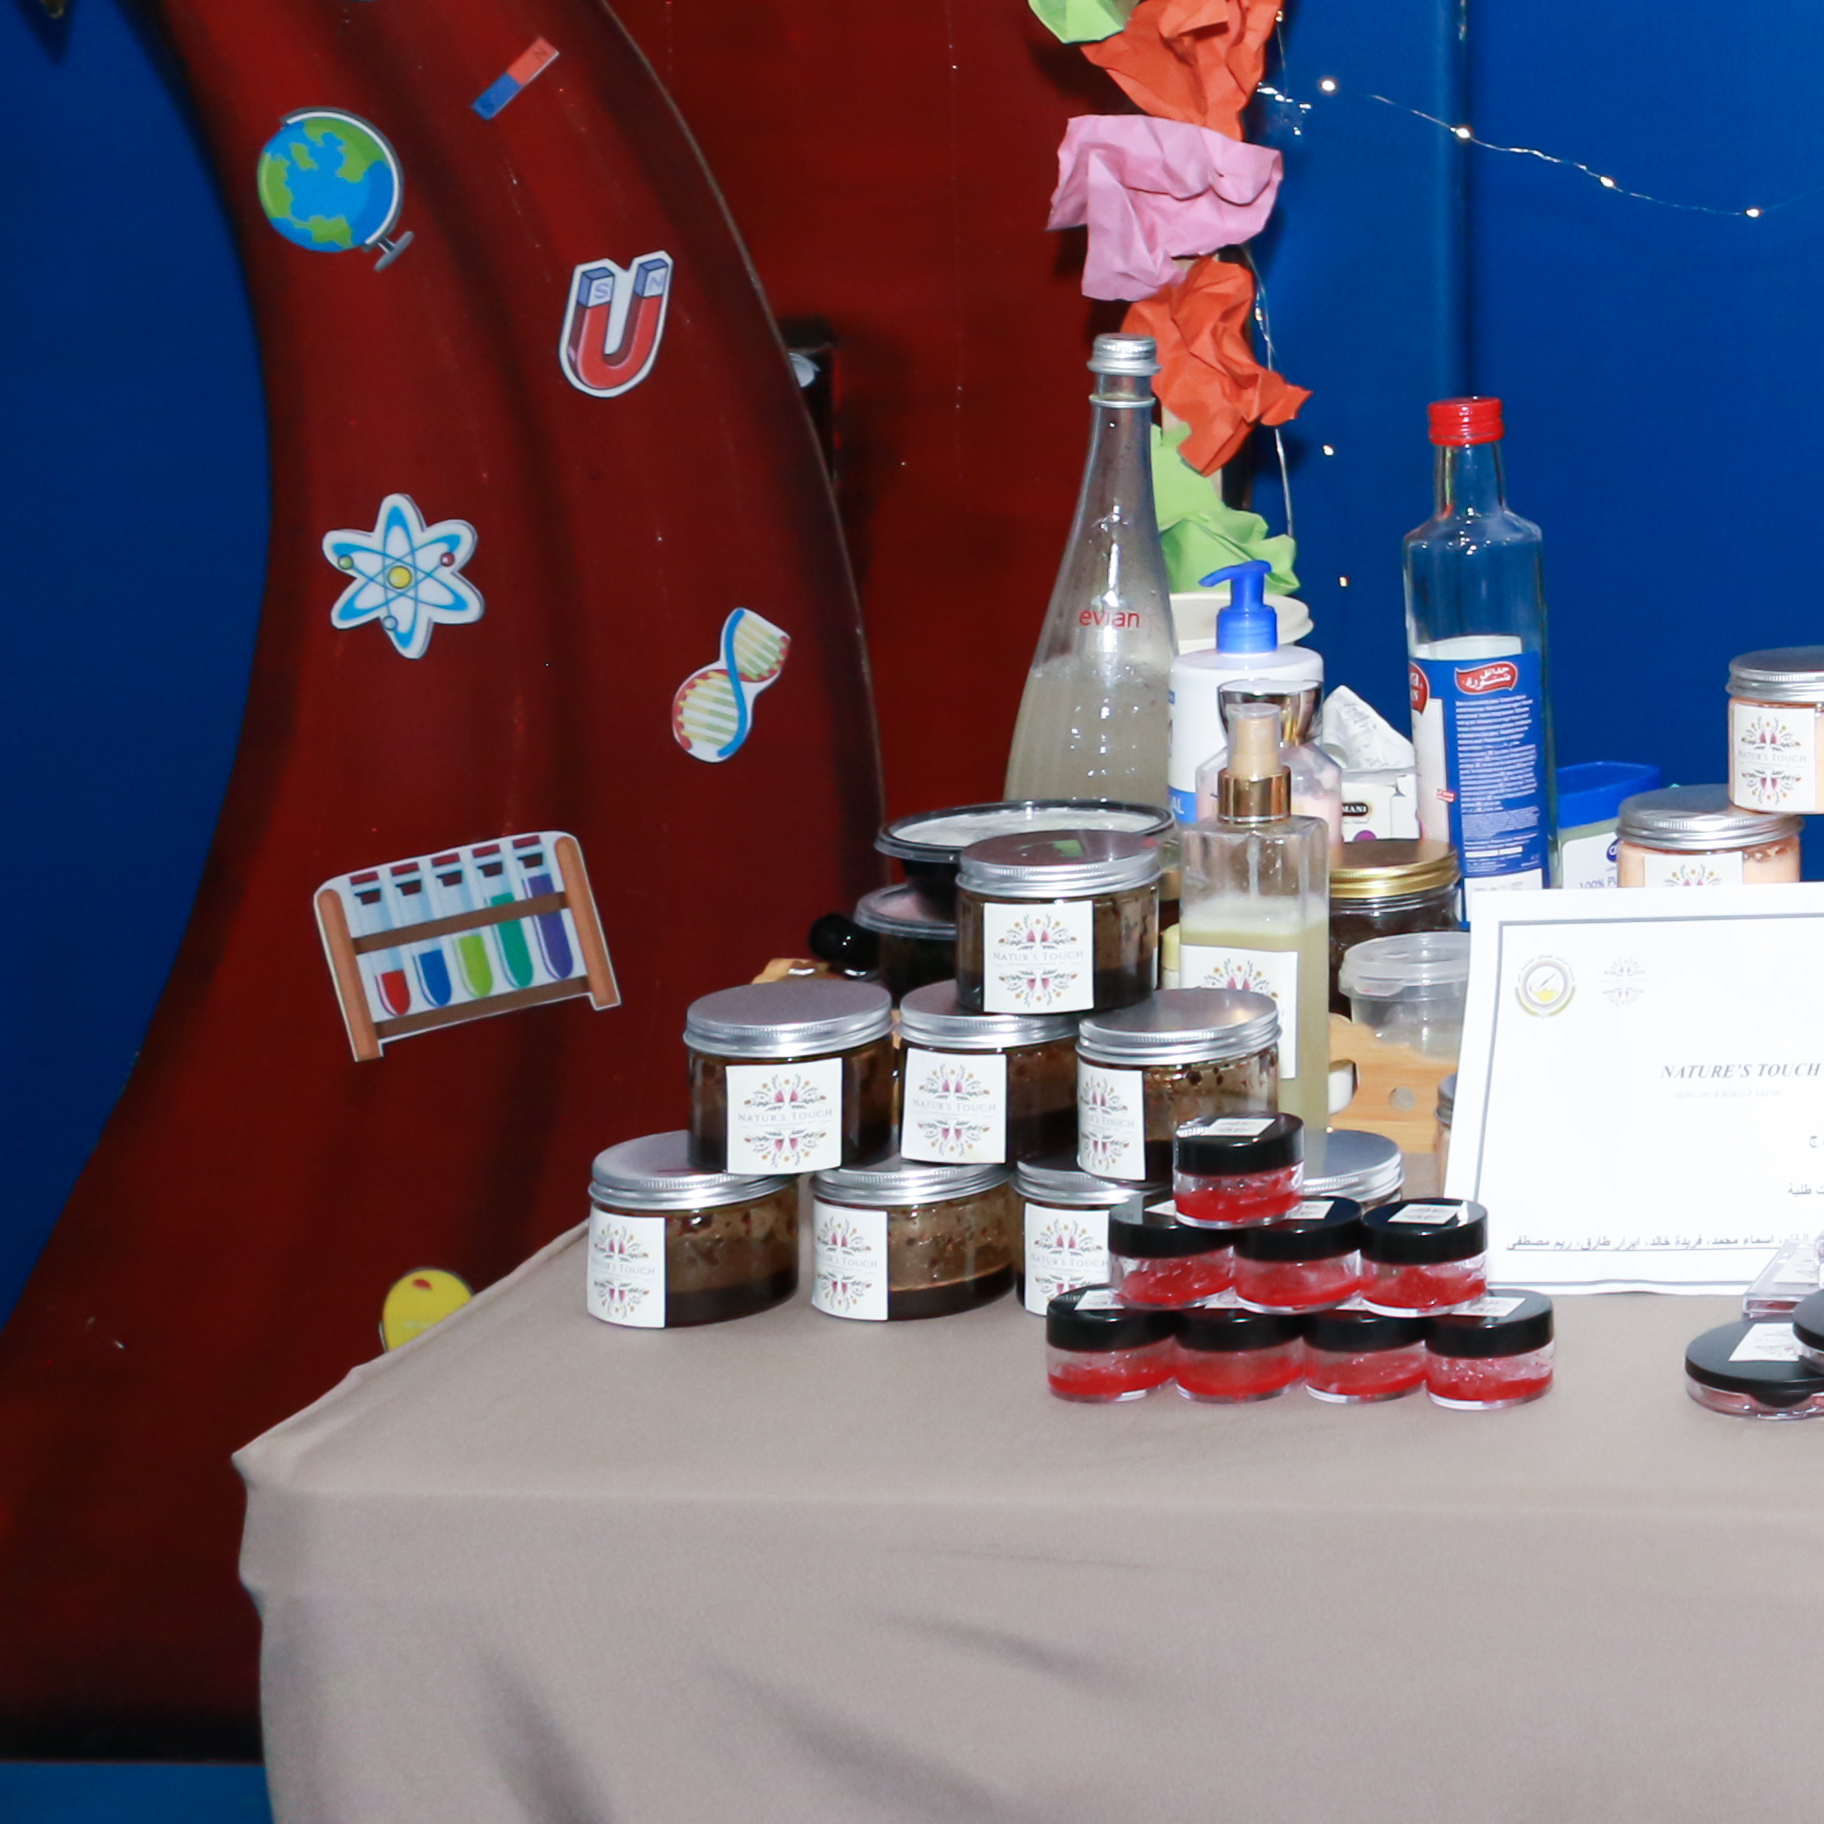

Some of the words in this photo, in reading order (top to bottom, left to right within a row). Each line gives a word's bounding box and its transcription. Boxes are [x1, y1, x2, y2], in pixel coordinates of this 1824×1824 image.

[1079, 609, 1141, 629] evian
[1658, 1062, 1754, 1080] NATURE'S
[1757, 1062, 1823, 1079] TOUCH
